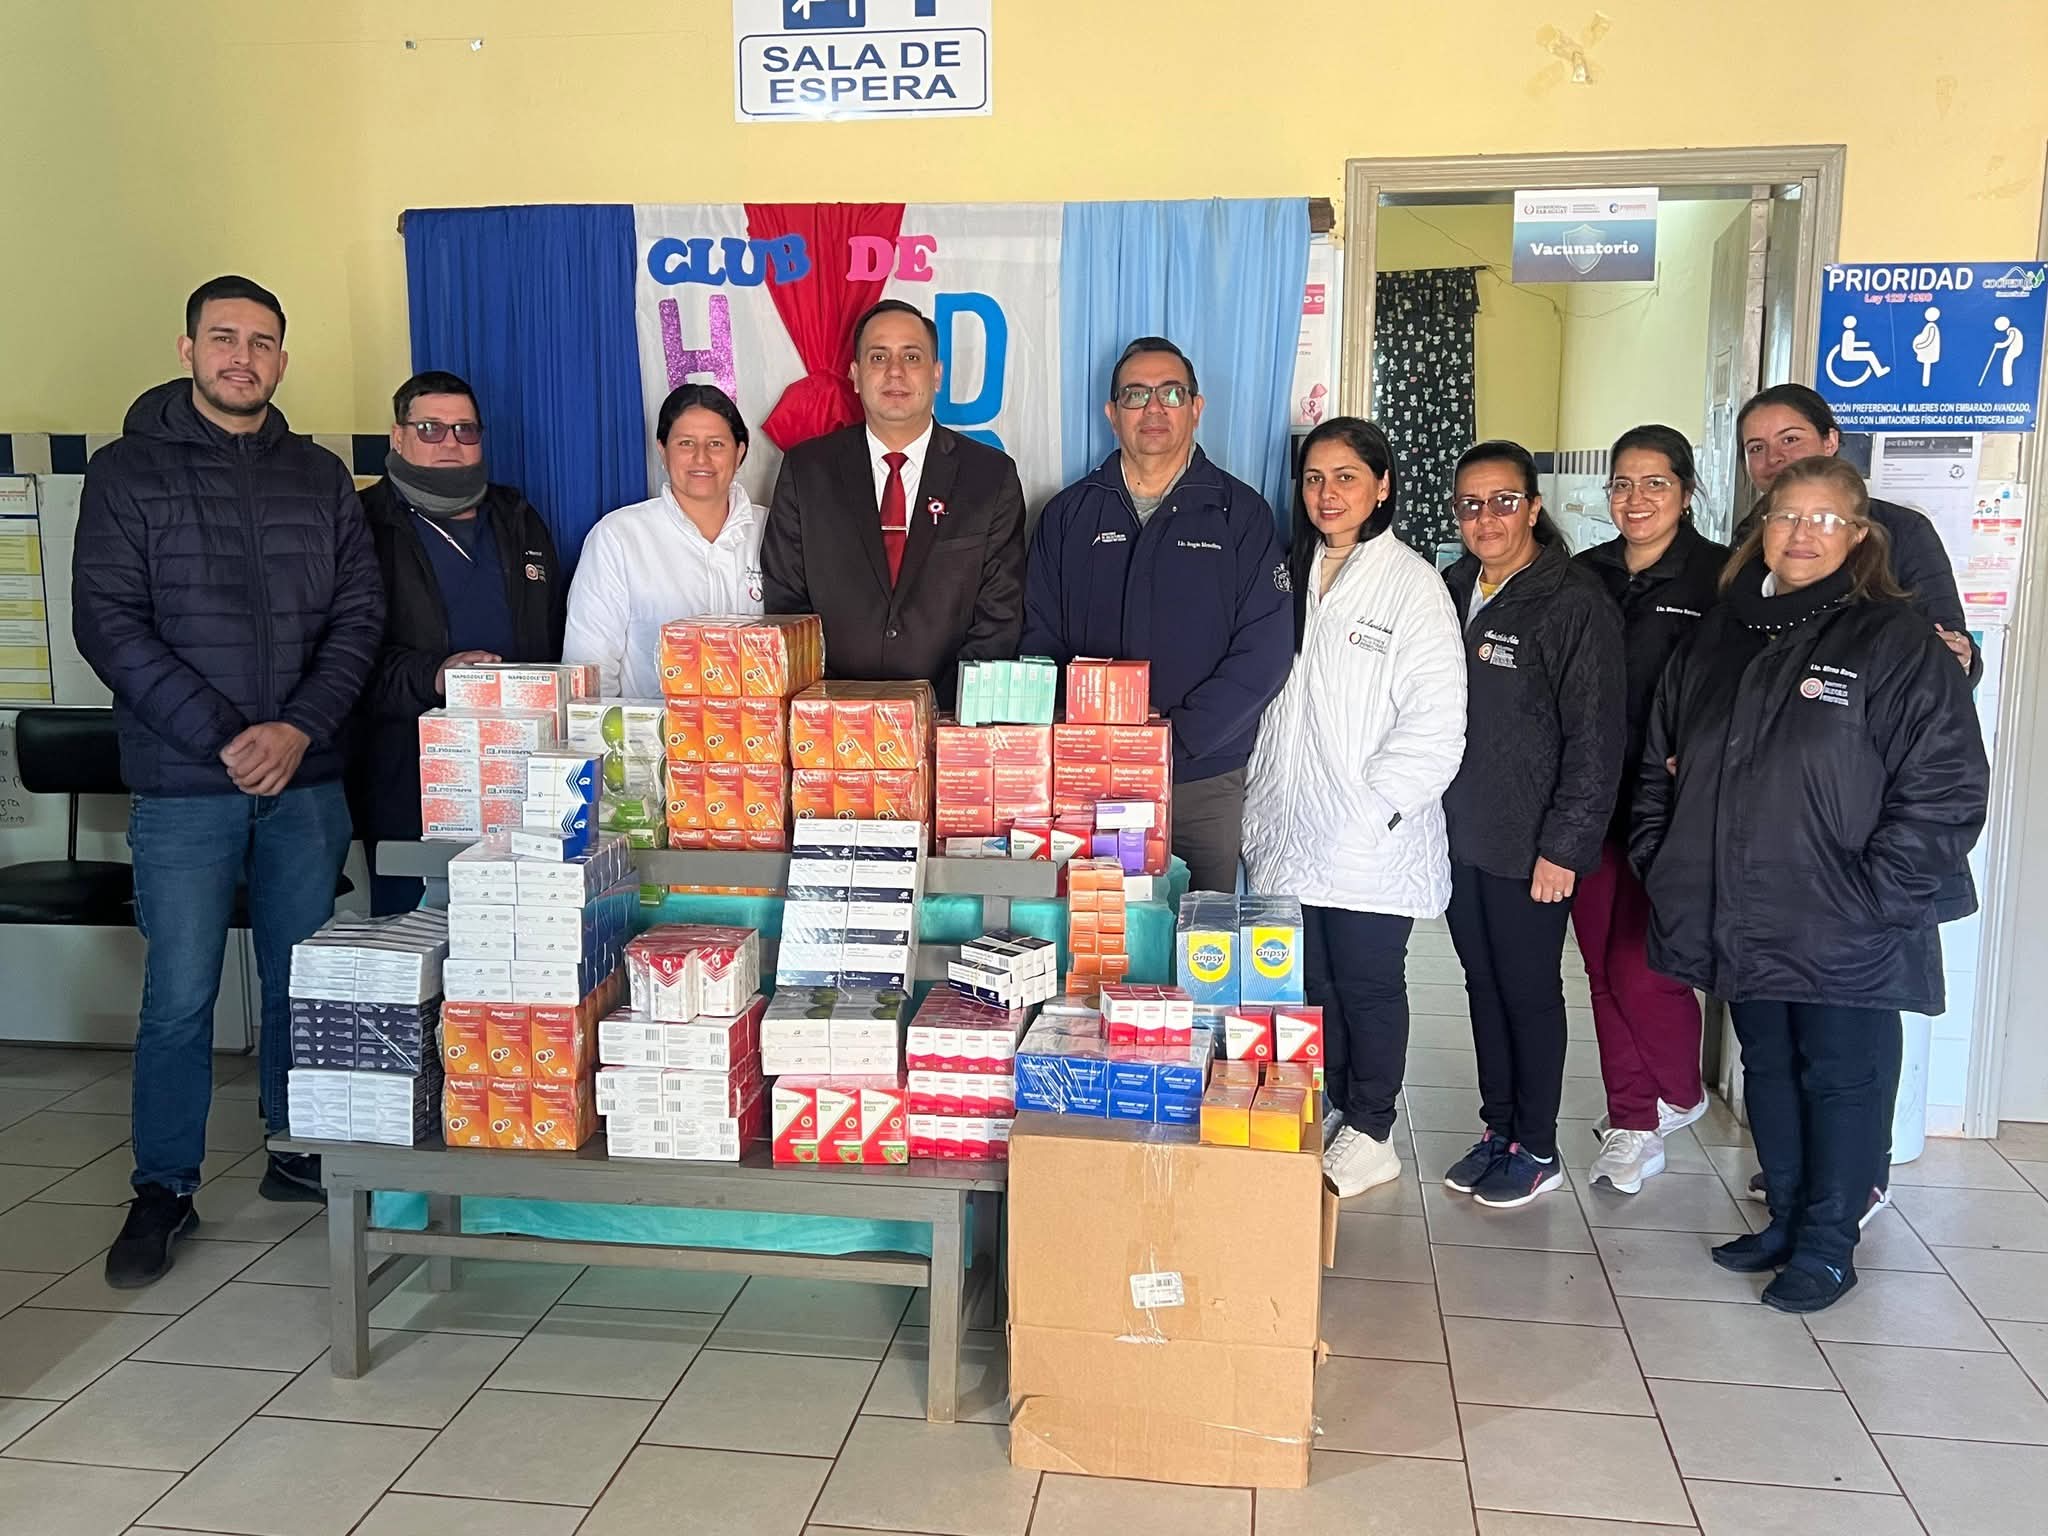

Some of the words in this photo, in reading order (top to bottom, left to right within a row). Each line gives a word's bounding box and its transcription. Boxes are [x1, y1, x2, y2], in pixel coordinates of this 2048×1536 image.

[762, 43, 886, 72] SALA
[901, 40, 961, 68] DE
[769, 74, 957, 104] ESPERA
[1530, 240, 1639, 256] Vacunatorio
[647, 233, 811, 287] CLUB
[846, 234, 937, 282] DE
[1828, 267, 1974, 292] PRIORIDAD
[1864, 293, 1883, 305] Ley
[1828, 402, 1851, 413] NCIÓN
[1852, 403, 1900, 413] PREFERENCIAL
[1907, 403, 1938, 413] MUJERES
[1940, 403, 1954, 412] CON
[1955, 403, 1992, 412] EMBARAZO
[1860, 415, 1874, 424] CON
[1875, 415, 1919, 424] LIMITACIONES
[1954, 415, 1964, 424] DE
[1964, 415, 1974, 424] LA
[1974, 415, 2006, 424] TERCERA
[2006, 415, 2025, 424] EDAD
[1192, 952, 1226, 963] Gripsyl
[1255, 948, 1289, 959] Gripsyl
